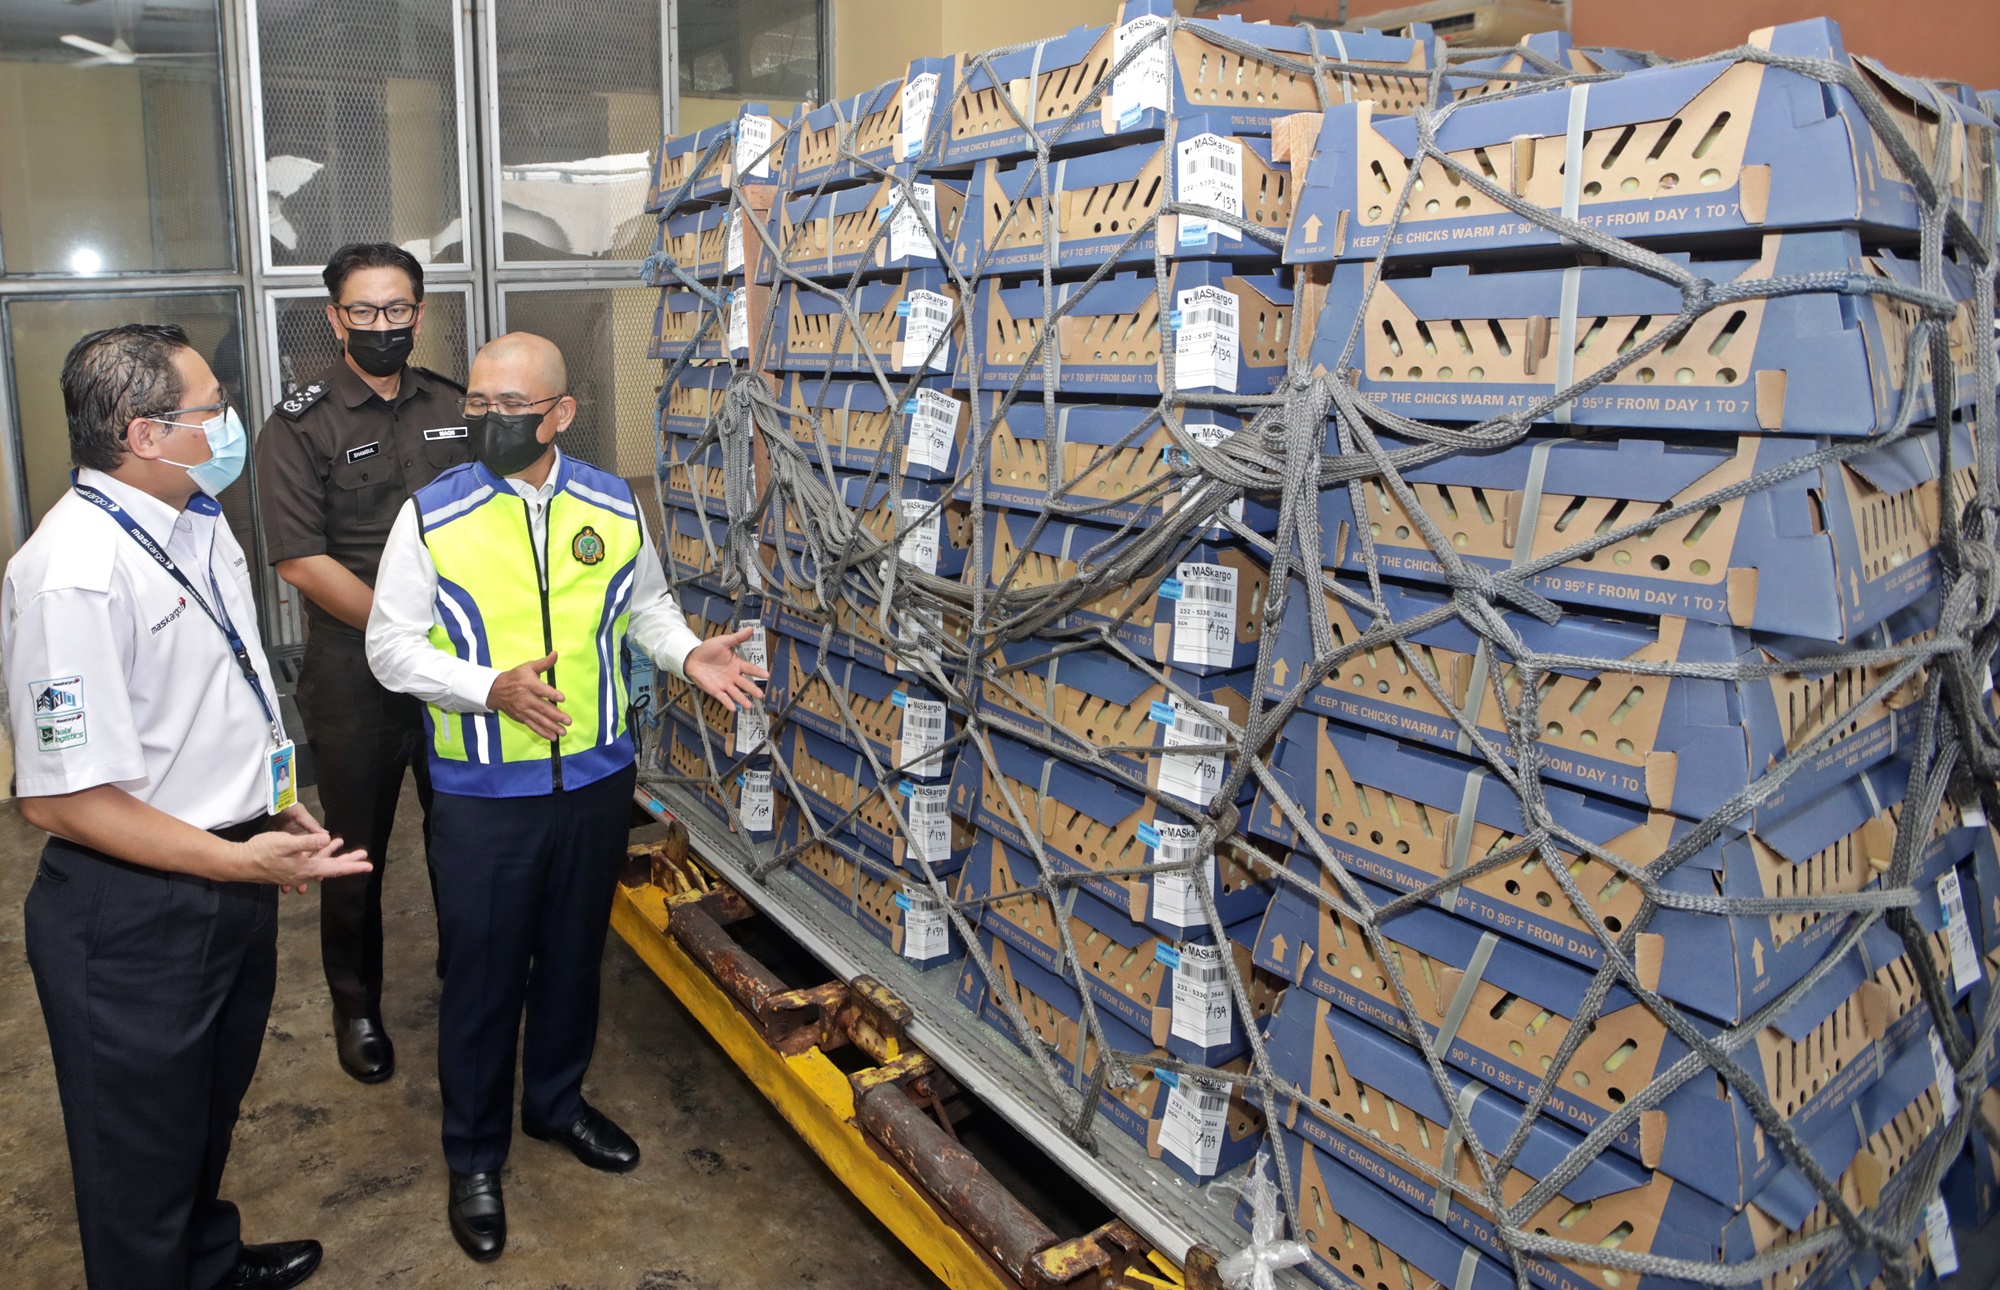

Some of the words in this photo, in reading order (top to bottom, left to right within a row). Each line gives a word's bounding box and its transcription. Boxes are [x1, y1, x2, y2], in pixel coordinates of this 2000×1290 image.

[1194, 136, 1235, 155] MASkargo
[1595, 214, 1603, 227] F
[1606, 210, 1650, 226] FROM
[1654, 207, 1689, 221] DAY
[1694, 206, 1701, 219] 1
[1706, 204, 1726, 218] TO
[1731, 203, 1739, 216] 7
[1352, 235, 1380, 248] KEEP
[1406, 227, 1449, 243] CHICKS
[1452, 225, 1495, 240] WARM
[1497, 223, 1515, 236] AT
[1194, 288, 1233, 306] MASkargo
[1360, 392, 1388, 403] KEEP
[1391, 392, 1412, 404] THE
[1414, 393, 1458, 405] CHICKS
[1461, 394, 1504, 406] WARM
[1507, 395, 1525, 407] AT
[1605, 397, 1613, 409] F
[1617, 398, 1660, 410] FROM
[1665, 399, 1699, 411] DAY
[1704, 400, 1710, 412] 1
[1717, 400, 1736, 413] TO
[1741, 401, 1749, 413] 7
[1202, 426, 1231, 441] MASka
[131, 528, 167, 564] maskargo
[1192, 566, 1232, 581] MASkargo
[1352, 552, 1379, 564] KEP
[1381, 555, 1401, 568] THE
[1404, 558, 1446, 574] CHICKS
[1533, 576, 1540, 586] F
[1545, 577, 1562, 590] TO
[1587, 583, 1595, 594] F
[1599, 584, 1640, 600] FROM
[1645, 590, 1678, 606] DAY
[1683, 596, 1689, 607] 1
[1695, 597, 1713, 611] TO
[1718, 600, 1726, 613] 7
[151, 604, 184, 635] maskargo
[1314, 694, 1338, 709] KEEP
[1340, 701, 1359, 715] THE
[1361, 707, 1398, 726] CHICKS
[1401, 717, 1438, 737] WARM
[1440, 729, 1456, 741] AT
[1576, 764, 1607, 783] DAY
[1611, 774, 1618, 785] 1
[1622, 776, 1639, 791] TO
[1167, 826, 1201, 838] MASkar
[1271, 829, 1281, 838] SIDE
[1281, 833, 1288, 841] UP
[1336, 850, 1354, 865] THE
[1356, 857, 1394, 879] CHICKS
[1470, 900, 1477, 912] F
[1481, 905, 1495, 920] TO
[1517, 919, 1525, 931] F
[1527, 923, 1564, 948] FROM
[1568, 939, 1598, 960] DAY
[1188, 945, 1222, 960] MASkarg
[1273, 963, 1284, 972] SIDE
[1284, 968, 1291, 976] UP
[1176, 983, 1188, 992] 232
[1192, 989, 1208, 999] 5330
[1211, 990, 1224, 998] 3644
[1312, 977, 1336, 996] KEEP
[1337, 989, 1356, 1007] THE
[1358, 1000, 1395, 1026] CHICKS
[1470, 1057, 1478, 1068] F
[1481, 1061, 1496, 1078] TO
[1517, 1080, 1526, 1091] F
[1528, 1085, 1565, 1113] FOM
[1568, 1105, 1598, 1128] DAY
[1171, 1099, 1183, 1110] 232
[1187, 1111, 1202, 1125] 5330
[1303, 1120, 1327, 1141] KEEP
[1329, 1135, 1347, 1155] THE
[1349, 1148, 1386, 1178] CHICKS
[1388, 1171, 1425, 1203] WARM
[1463, 1218, 1470, 1229] F
[1474, 1224, 1488, 1242] TO
